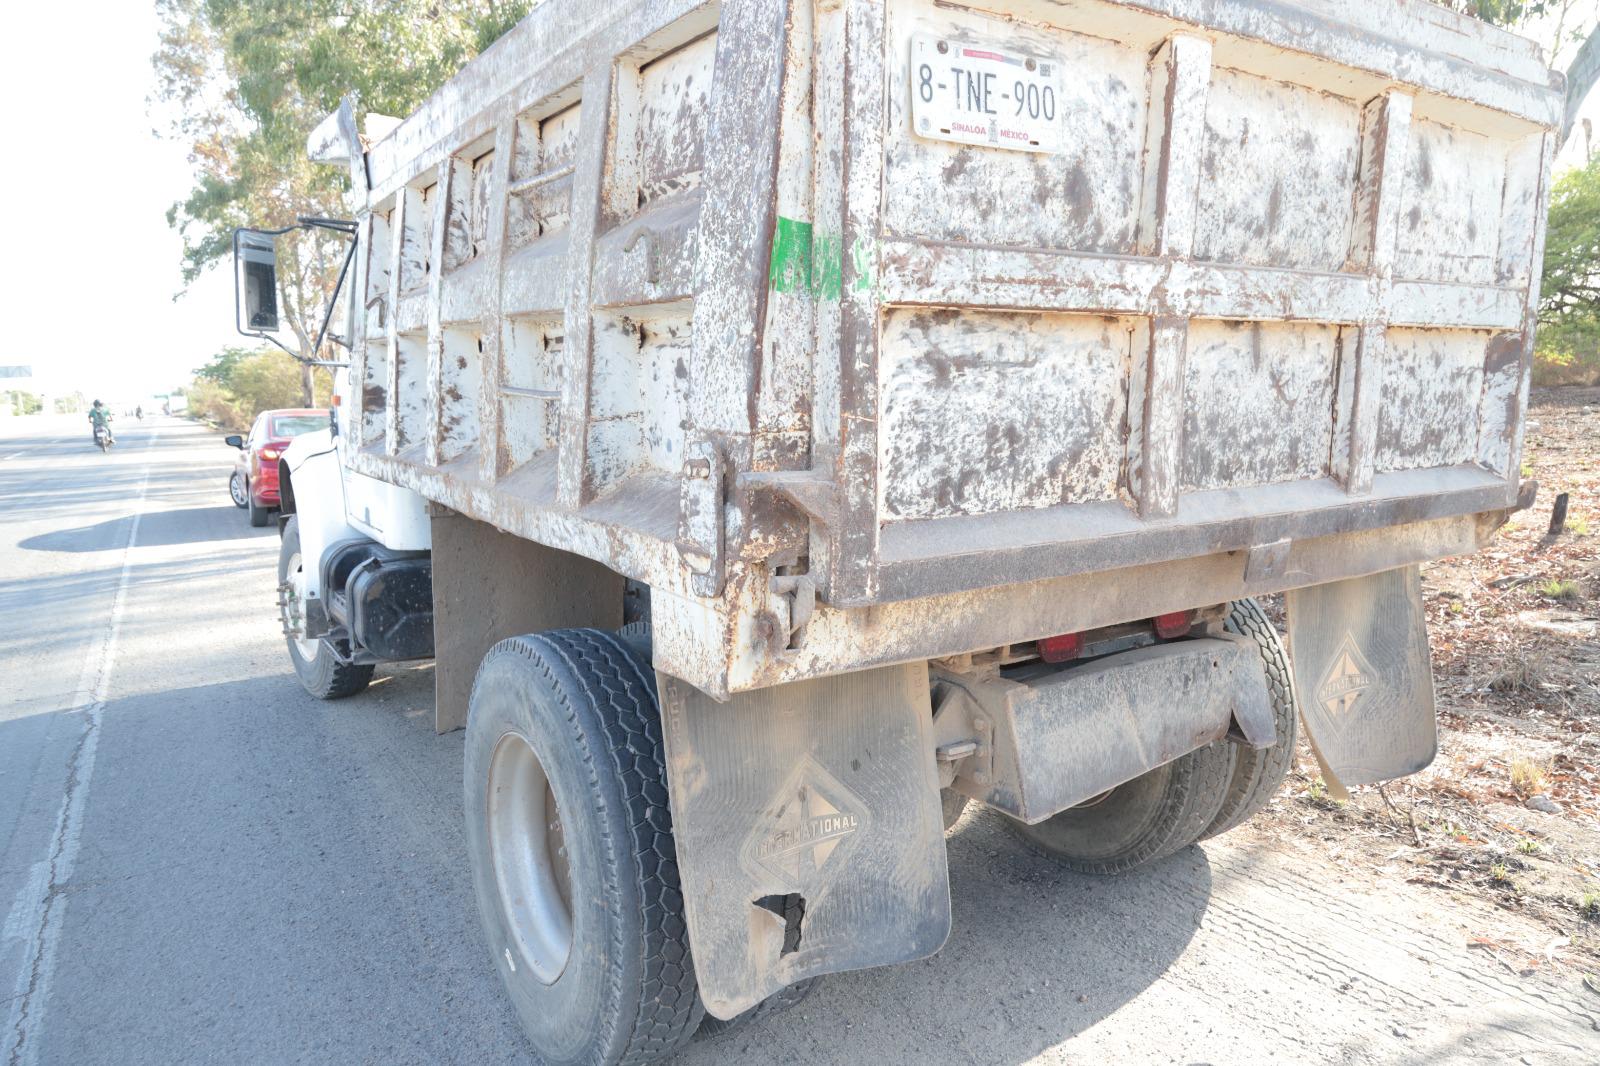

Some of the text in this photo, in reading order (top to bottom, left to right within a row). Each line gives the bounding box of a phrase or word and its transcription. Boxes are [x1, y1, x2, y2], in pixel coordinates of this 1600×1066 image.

[919, 63, 1056, 121] 8-TNE-900
[951, 122, 1029, 141] SINALOA MÉXICO
